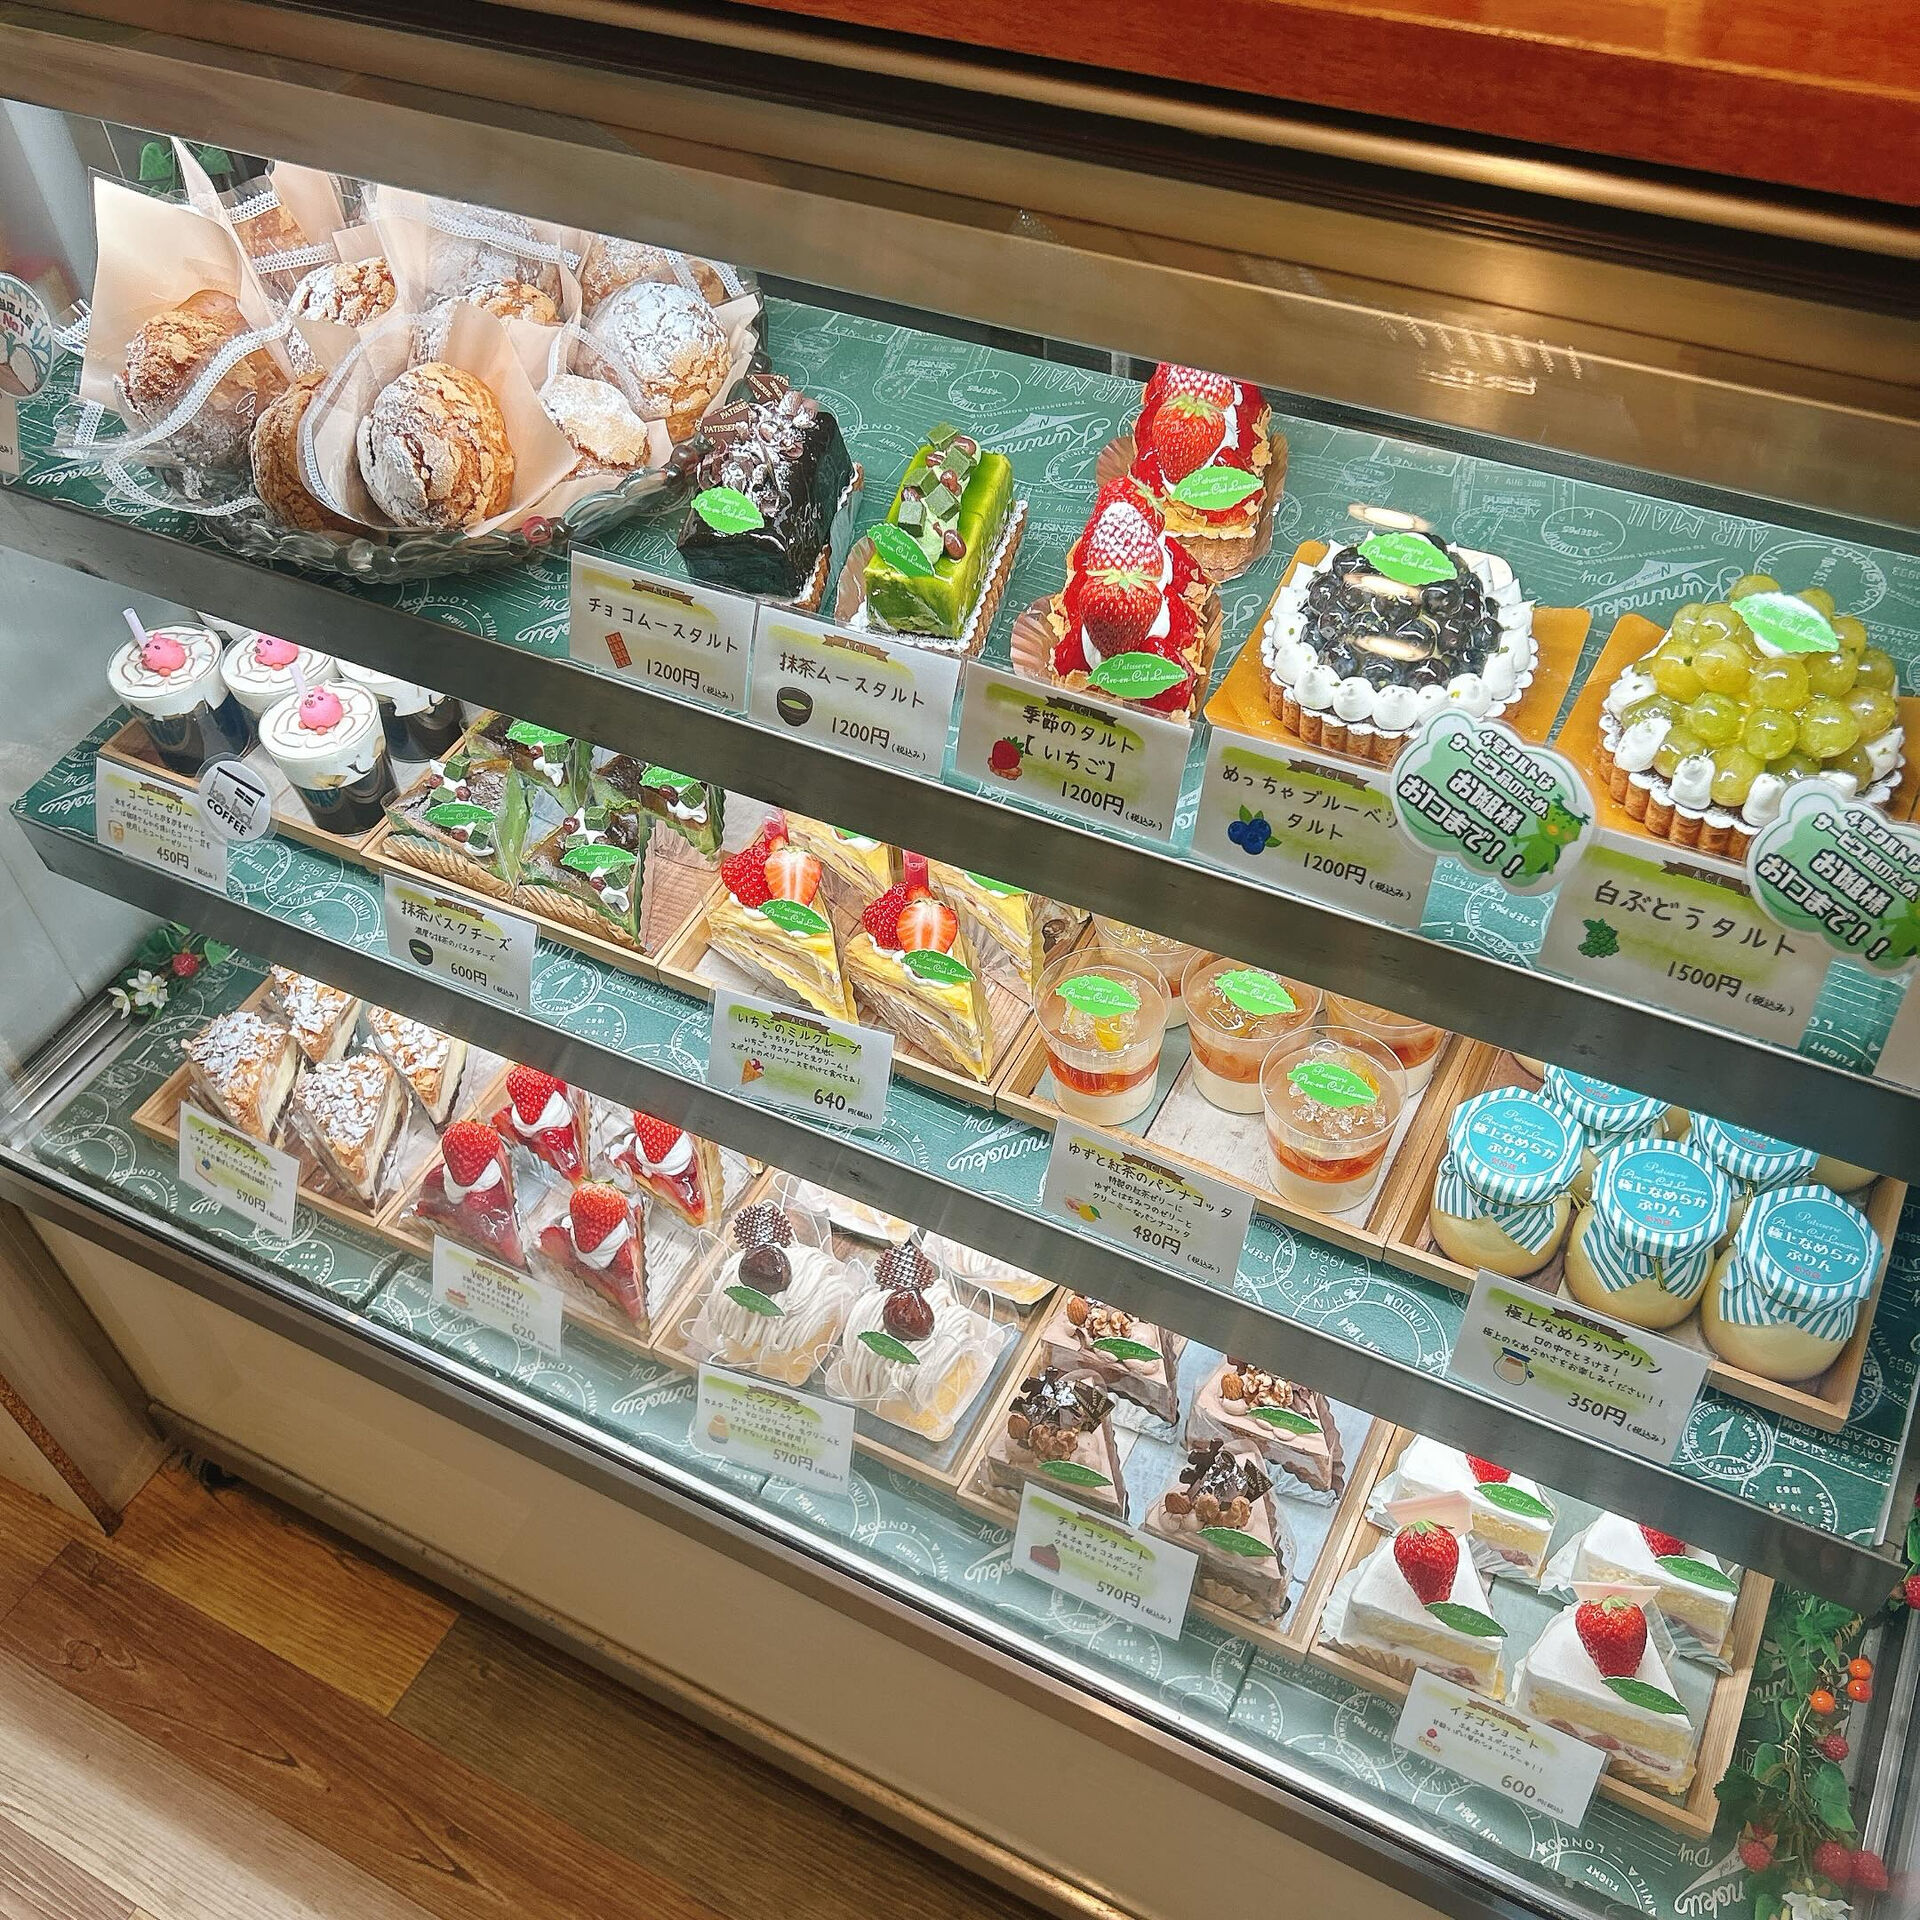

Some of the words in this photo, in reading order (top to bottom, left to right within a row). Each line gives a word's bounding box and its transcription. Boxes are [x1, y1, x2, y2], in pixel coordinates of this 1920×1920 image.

[1023, 363, 1092, 396] MAIL
[1626, 500, 1704, 539] MAIL
[1710, 520, 1768, 552] AIR
[589, 598, 738, 653] チョコムースタルト
[647, 659, 700, 690] 1200円
[779, 652, 925, 708] 抹茶ムースタルト
[832, 717, 890, 749] 1200円
[1022, 706, 1135, 753] 季節のタルト
[1024, 735, 1116, 782] 【いちご】
[1479, 730, 1556, 792] 4号タルトは
[129, 789, 193, 817] コーヒーゼリー
[1062, 781, 1124, 817] 1200円
[207, 799, 247, 836] COFFEE
[1287, 813, 1344, 840] タルト
[157, 847, 189, 869] 450円
[1304, 852, 1366, 885] 1200円
[342, 892, 371, 920] LONDON
[1594, 880, 1796, 956] 白ぶどうタルト
[401, 900, 513, 951] 抹茶バスクチーズ
[451, 963, 487, 987] 600円
[1667, 961, 1742, 998] 1500円
[738, 1014, 862, 1055] いちごのミルクレープ
[1809, 1042, 1856, 1067] FLIGHT
[814, 1088, 846, 1111] 640
[962, 1115, 994, 1134] Diy
[875, 1135, 900, 1155] FLIGHT
[1068, 1142, 1232, 1219] ゆずと紅茶のパンナコッタ
[236, 1189, 266, 1212] 570円
[1133, 1225, 1181, 1255] 480円
[1309, 1247, 1344, 1268] 1968
[471, 1269, 493, 1286] Very
[497, 1281, 524, 1300] Berry
[1382, 1294, 1430, 1332] LONDON
[512, 1323, 535, 1341] 620
[1504, 1303, 1662, 1375] 極上なめらかプリン
[745, 1390, 803, 1415] モンブラン
[1568, 1392, 1627, 1428] 350円
[1781, 1418, 1817, 1437] FROM
[1819, 1434, 1849, 1449] STAY
[773, 1449, 813, 1471] 570円
[1852, 1446, 1882, 1462] DAYS
[1057, 1516, 1148, 1561] チョコショート
[1096, 1581, 1140, 1609] 570円
[1450, 1705, 1540, 1750] イチゴショート
[1501, 1774, 1536, 1799] 600
[1677, 1845, 1712, 1868] Diy
[1585, 1865, 1619, 1893] FLIGHT
